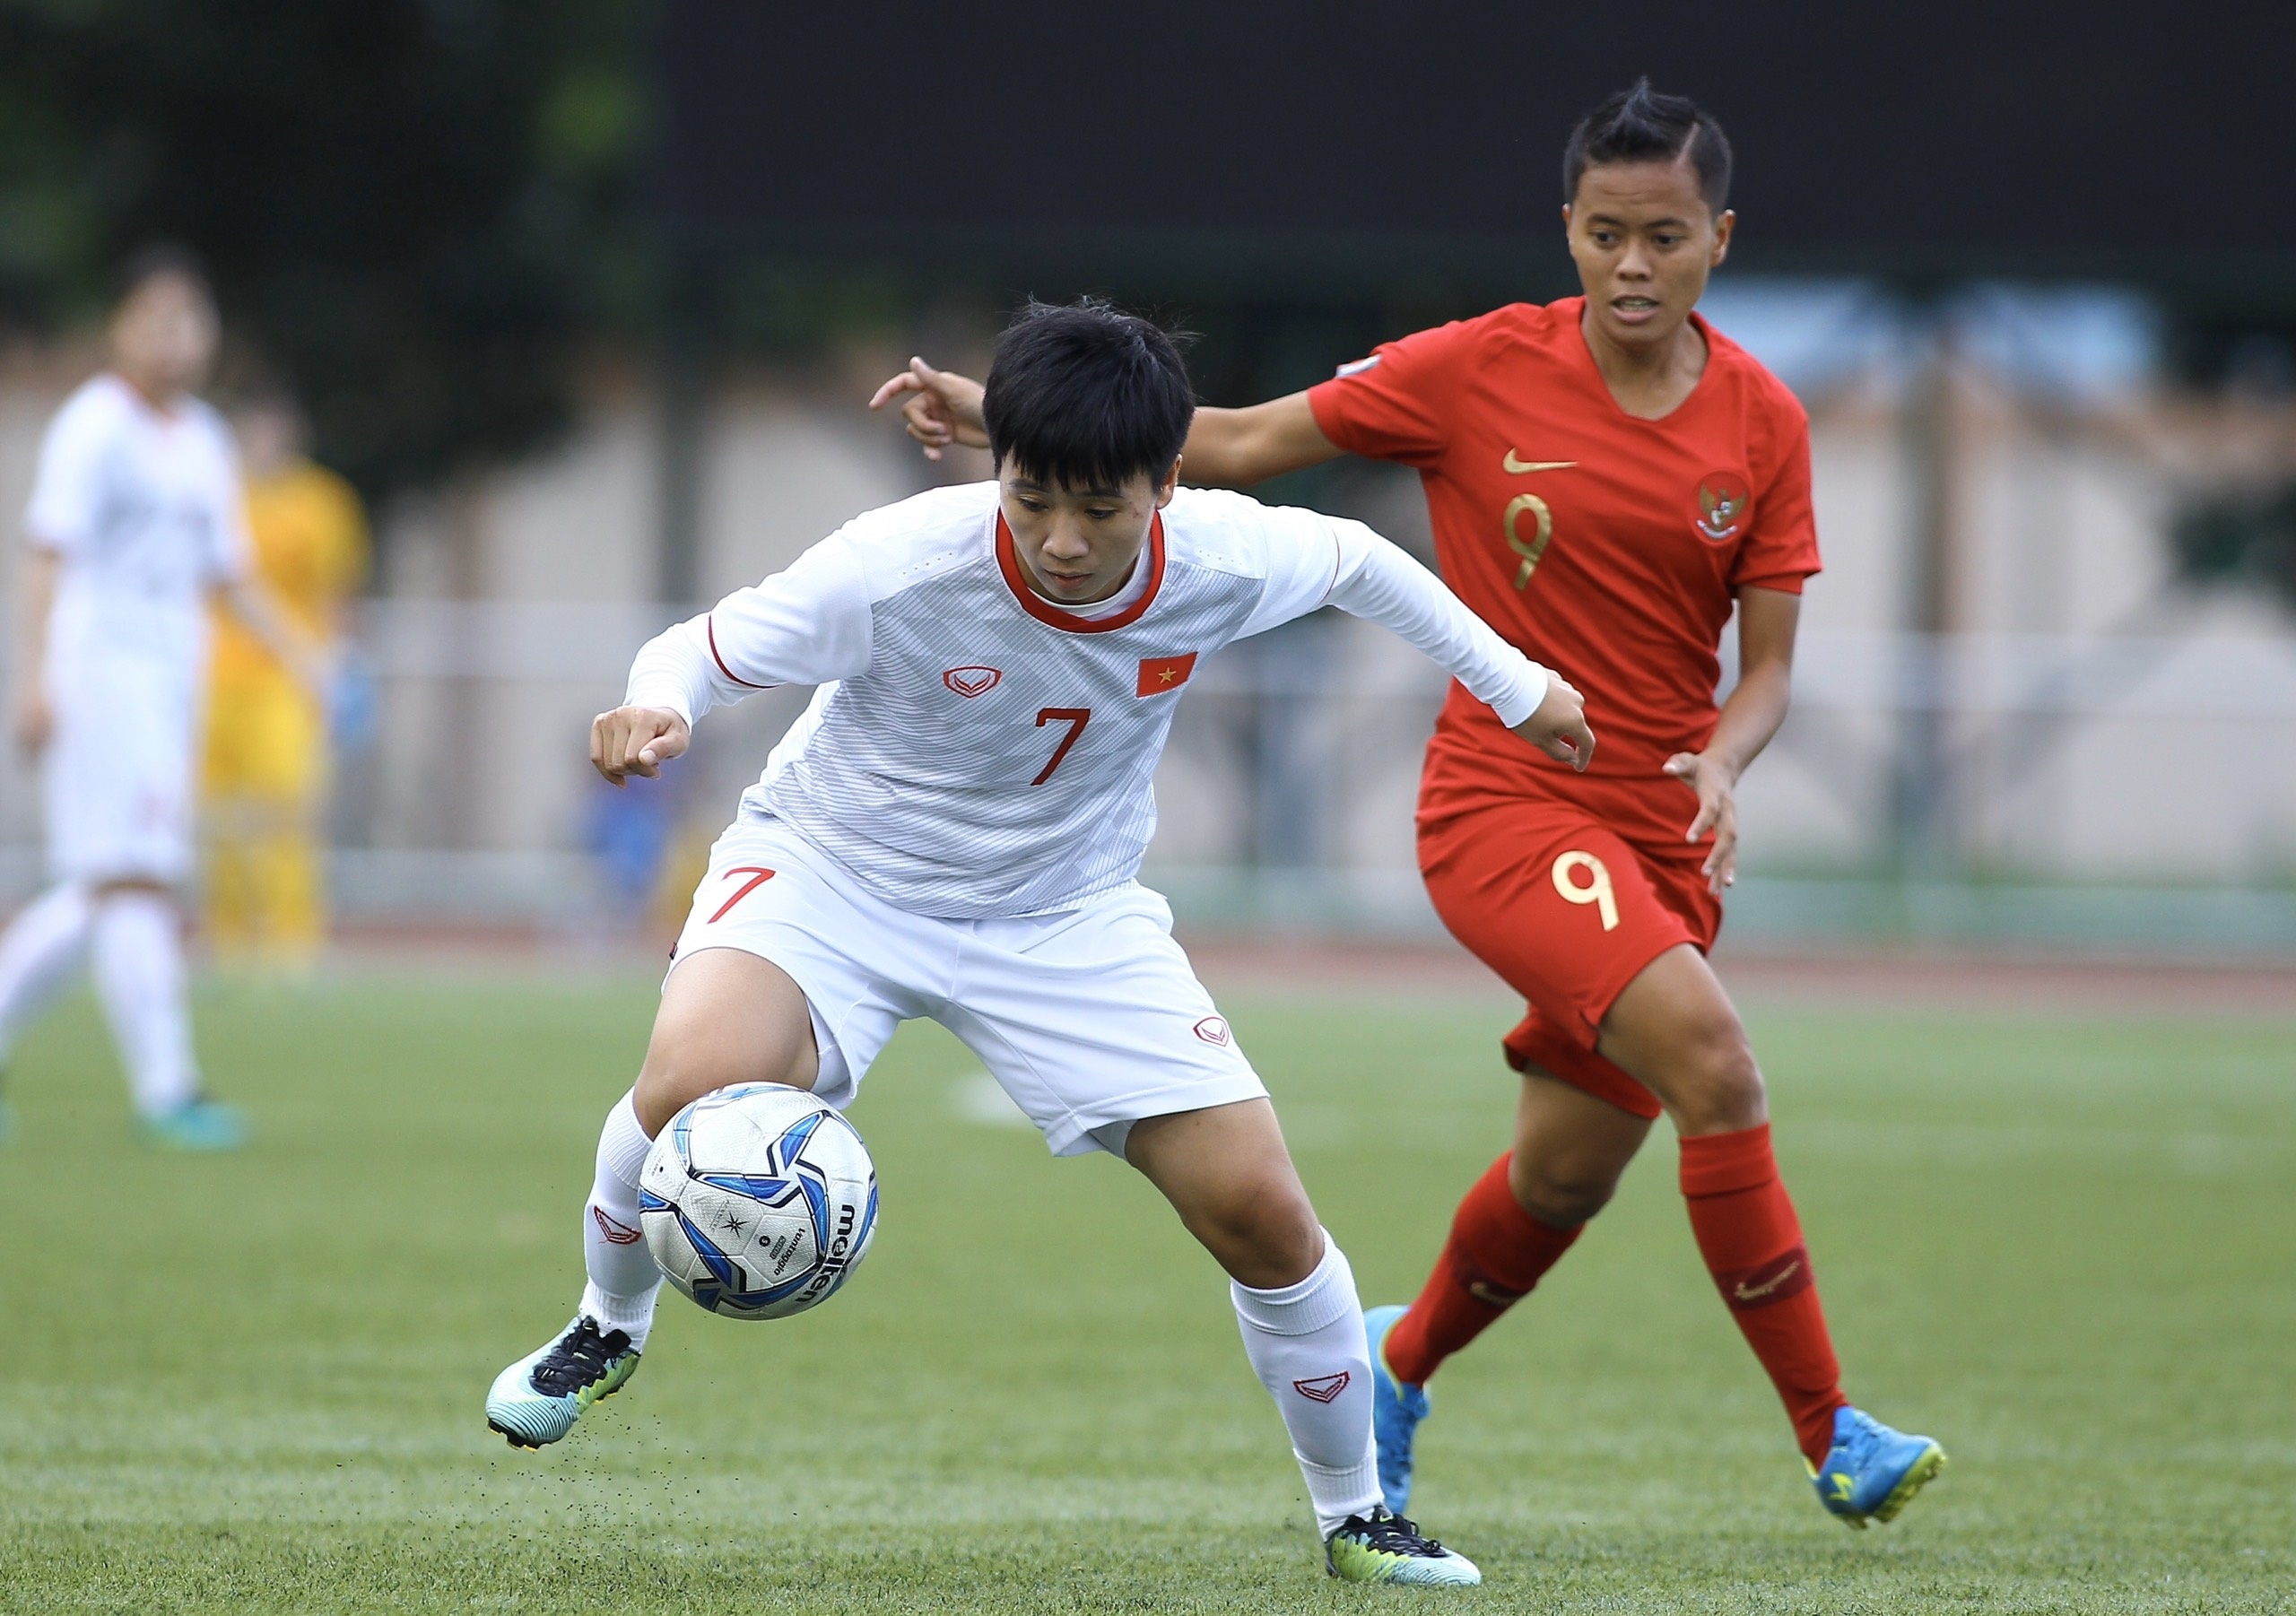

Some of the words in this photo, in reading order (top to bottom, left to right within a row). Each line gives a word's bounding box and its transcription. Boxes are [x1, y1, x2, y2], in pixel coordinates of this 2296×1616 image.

[1503, 492, 1552, 590] 9
[1031, 708, 1091, 786] 7
[707, 866, 776, 925] 7
[1551, 849, 1620, 933] 9
[773, 1228, 805, 1276] vantaggio
[795, 1204, 856, 1303] molten
